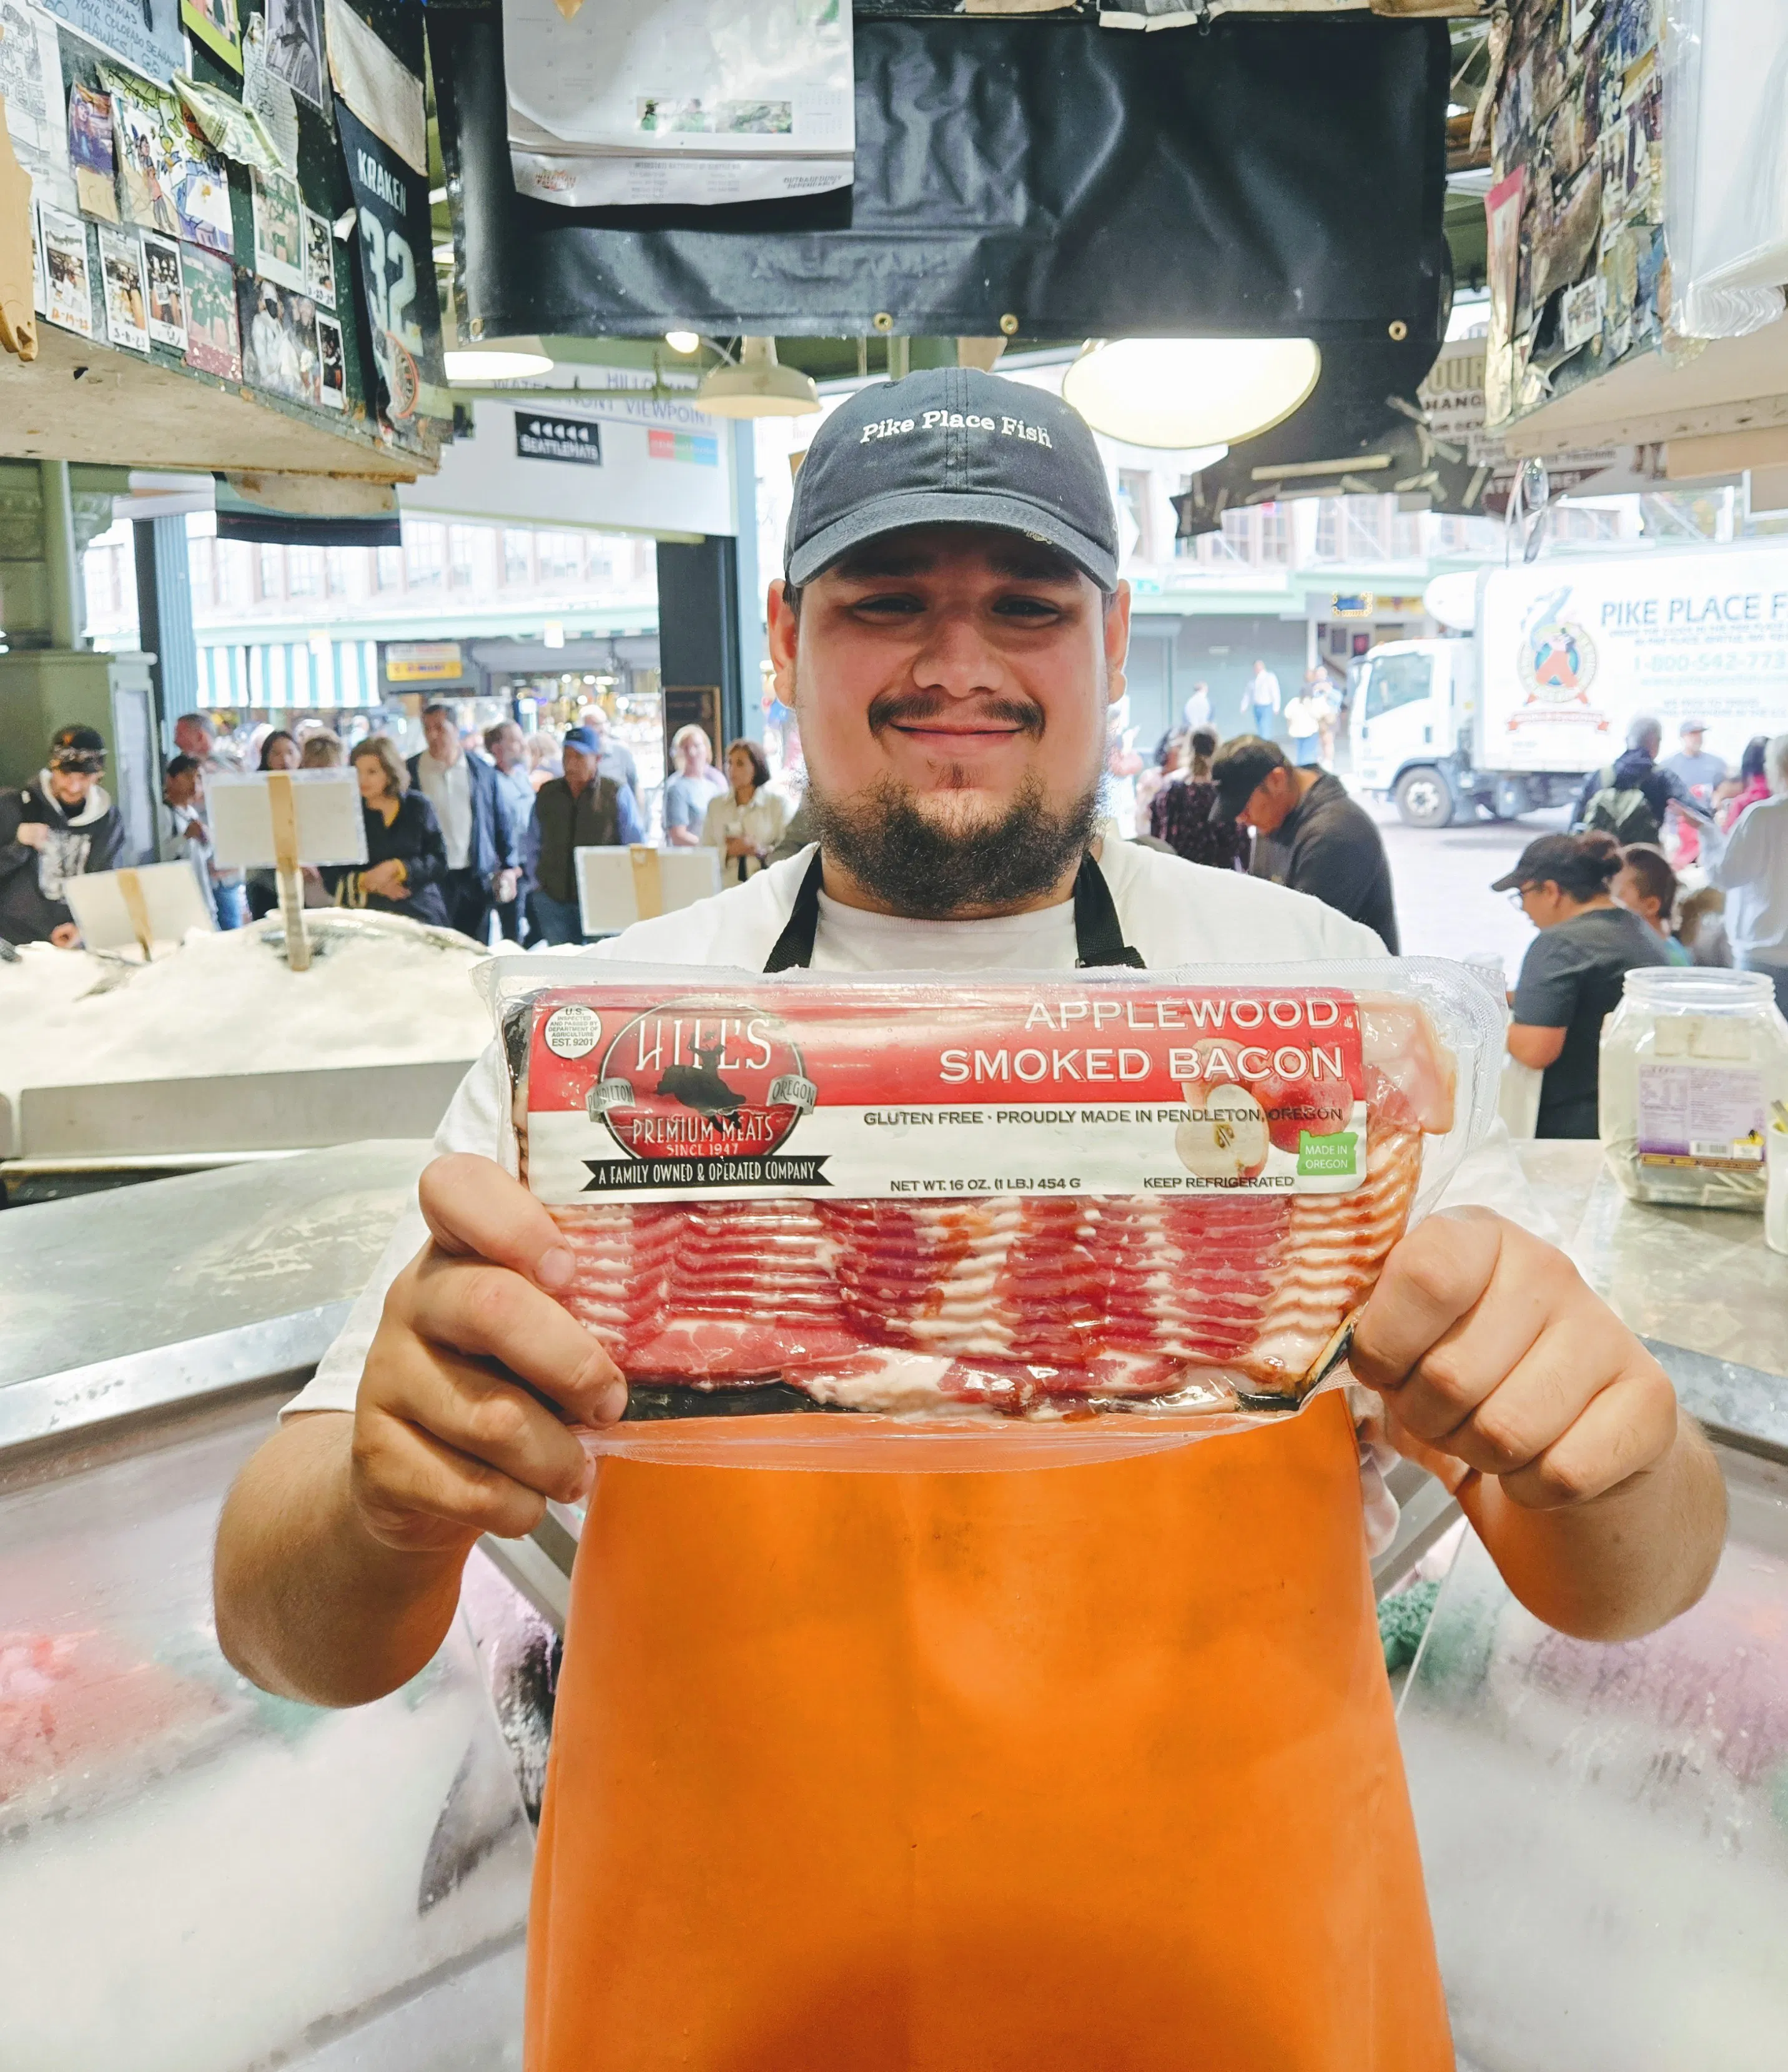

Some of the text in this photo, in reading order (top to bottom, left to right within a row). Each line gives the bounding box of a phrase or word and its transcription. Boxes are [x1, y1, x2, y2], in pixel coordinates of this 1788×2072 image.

[357, 148, 406, 216] KRAKEN
[360, 205, 424, 357] 32
[860, 410, 1052, 448] Pike Place Fish
[1601, 599, 1659, 627] PIKE
[1668, 592, 1762, 623] PLACE
[1024, 998, 1340, 1031] APPLEWOOD
[552, 1038, 593, 1047] EST. 9201
[939, 1045, 1346, 1084] SMOKED BACON
[772, 1078, 816, 1105] OREGON
[864, 1108, 1343, 1125] GLUTEN FREE PROUDLY MADE IN PENDLETON, OREGON
[632, 1115, 774, 1144] PREMIUM MEATS
[666, 1143, 738, 1157] SINCE 1947
[1305, 1145, 1347, 1155] MADE IN
[598, 1162, 816, 1185] A FAMILY OWNED & OPERATED COMPANY
[1305, 1159, 1348, 1169] OREGON
[891, 1178, 1081, 1191] NET WT. 16 OZ. (1 LB.) 454 G
[1143, 1176, 1295, 1188] KEEP REFRIGERATED
